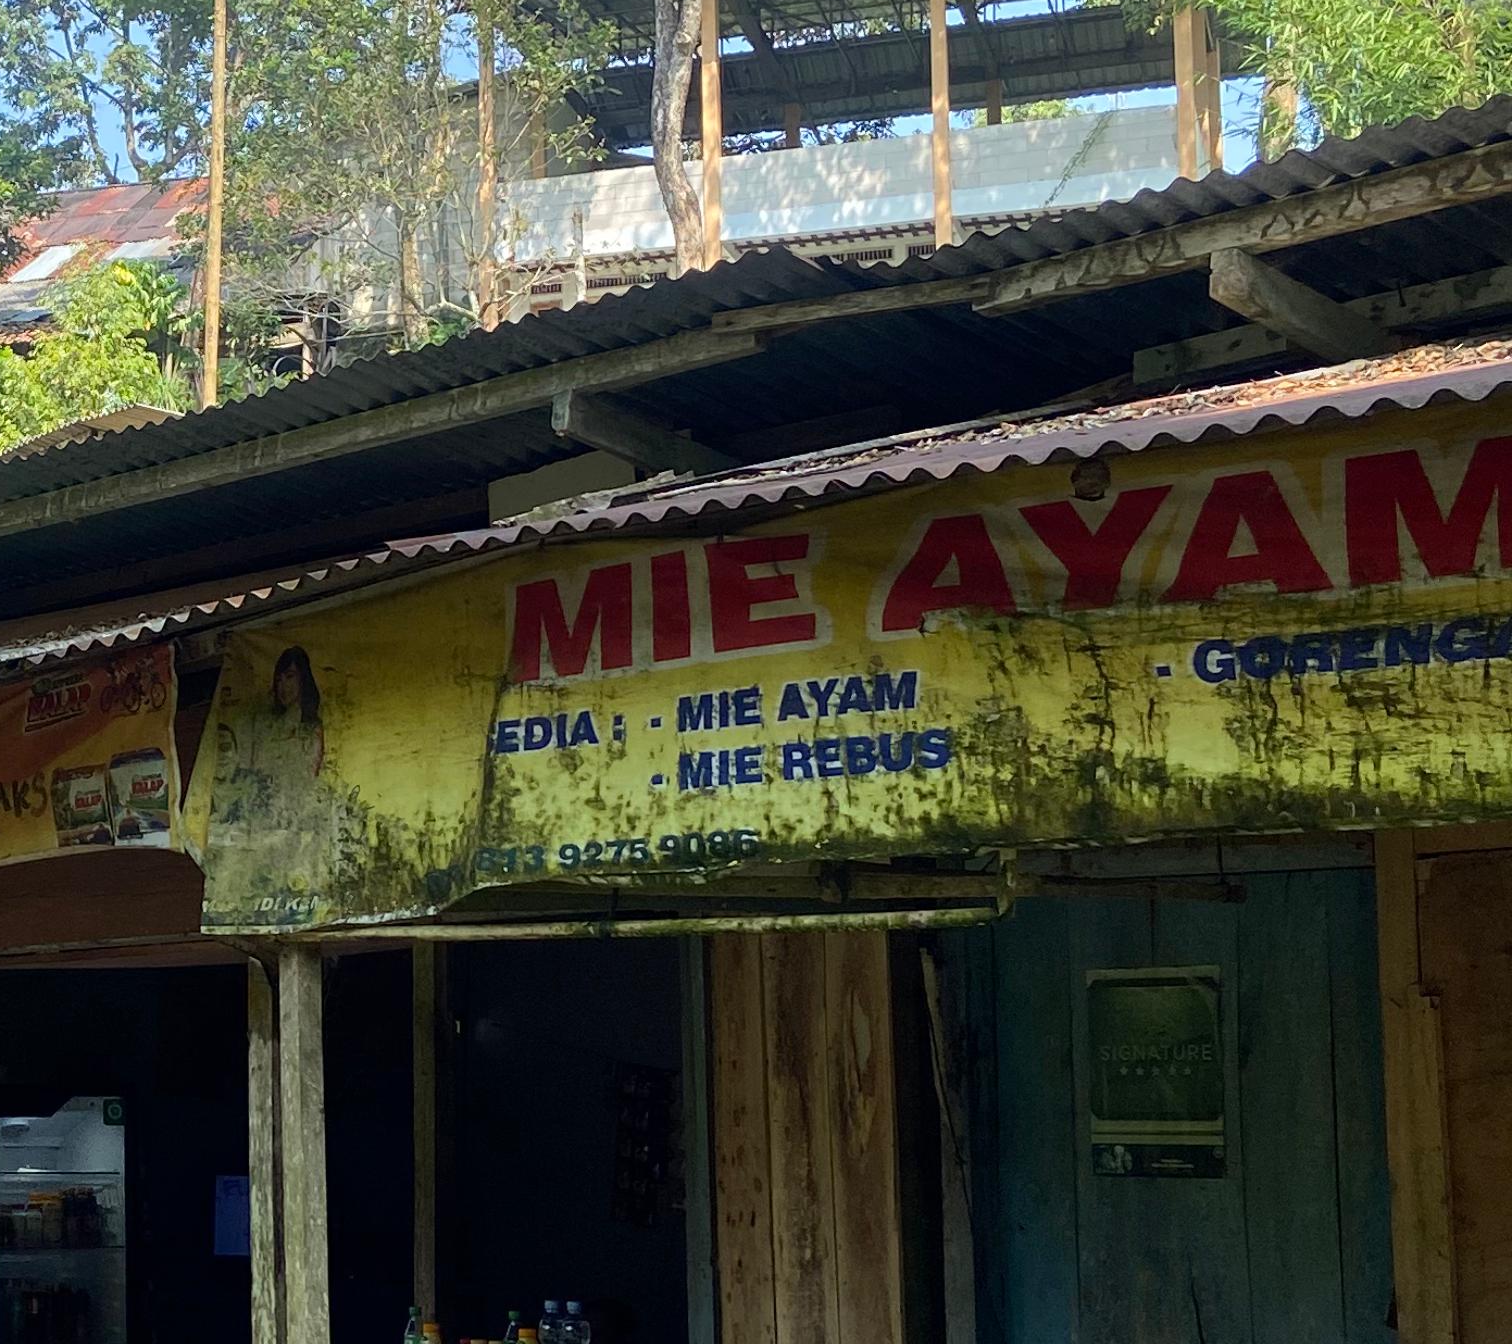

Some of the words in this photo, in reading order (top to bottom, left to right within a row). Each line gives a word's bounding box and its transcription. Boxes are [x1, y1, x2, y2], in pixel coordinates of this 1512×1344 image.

[511, 533, 816, 683] MIE
[882, 435, 1512, 632] AYAM
[492, 710, 599, 754] EDIA
[678, 686, 763, 732] MIE
[777, 671, 919, 722] AYAM
[678, 746, 763, 792] MIE
[782, 729, 952, 783] REBUS
[558, 837, 650, 870] 9275
[1099, 1043, 1213, 1062] SIGNATURE
